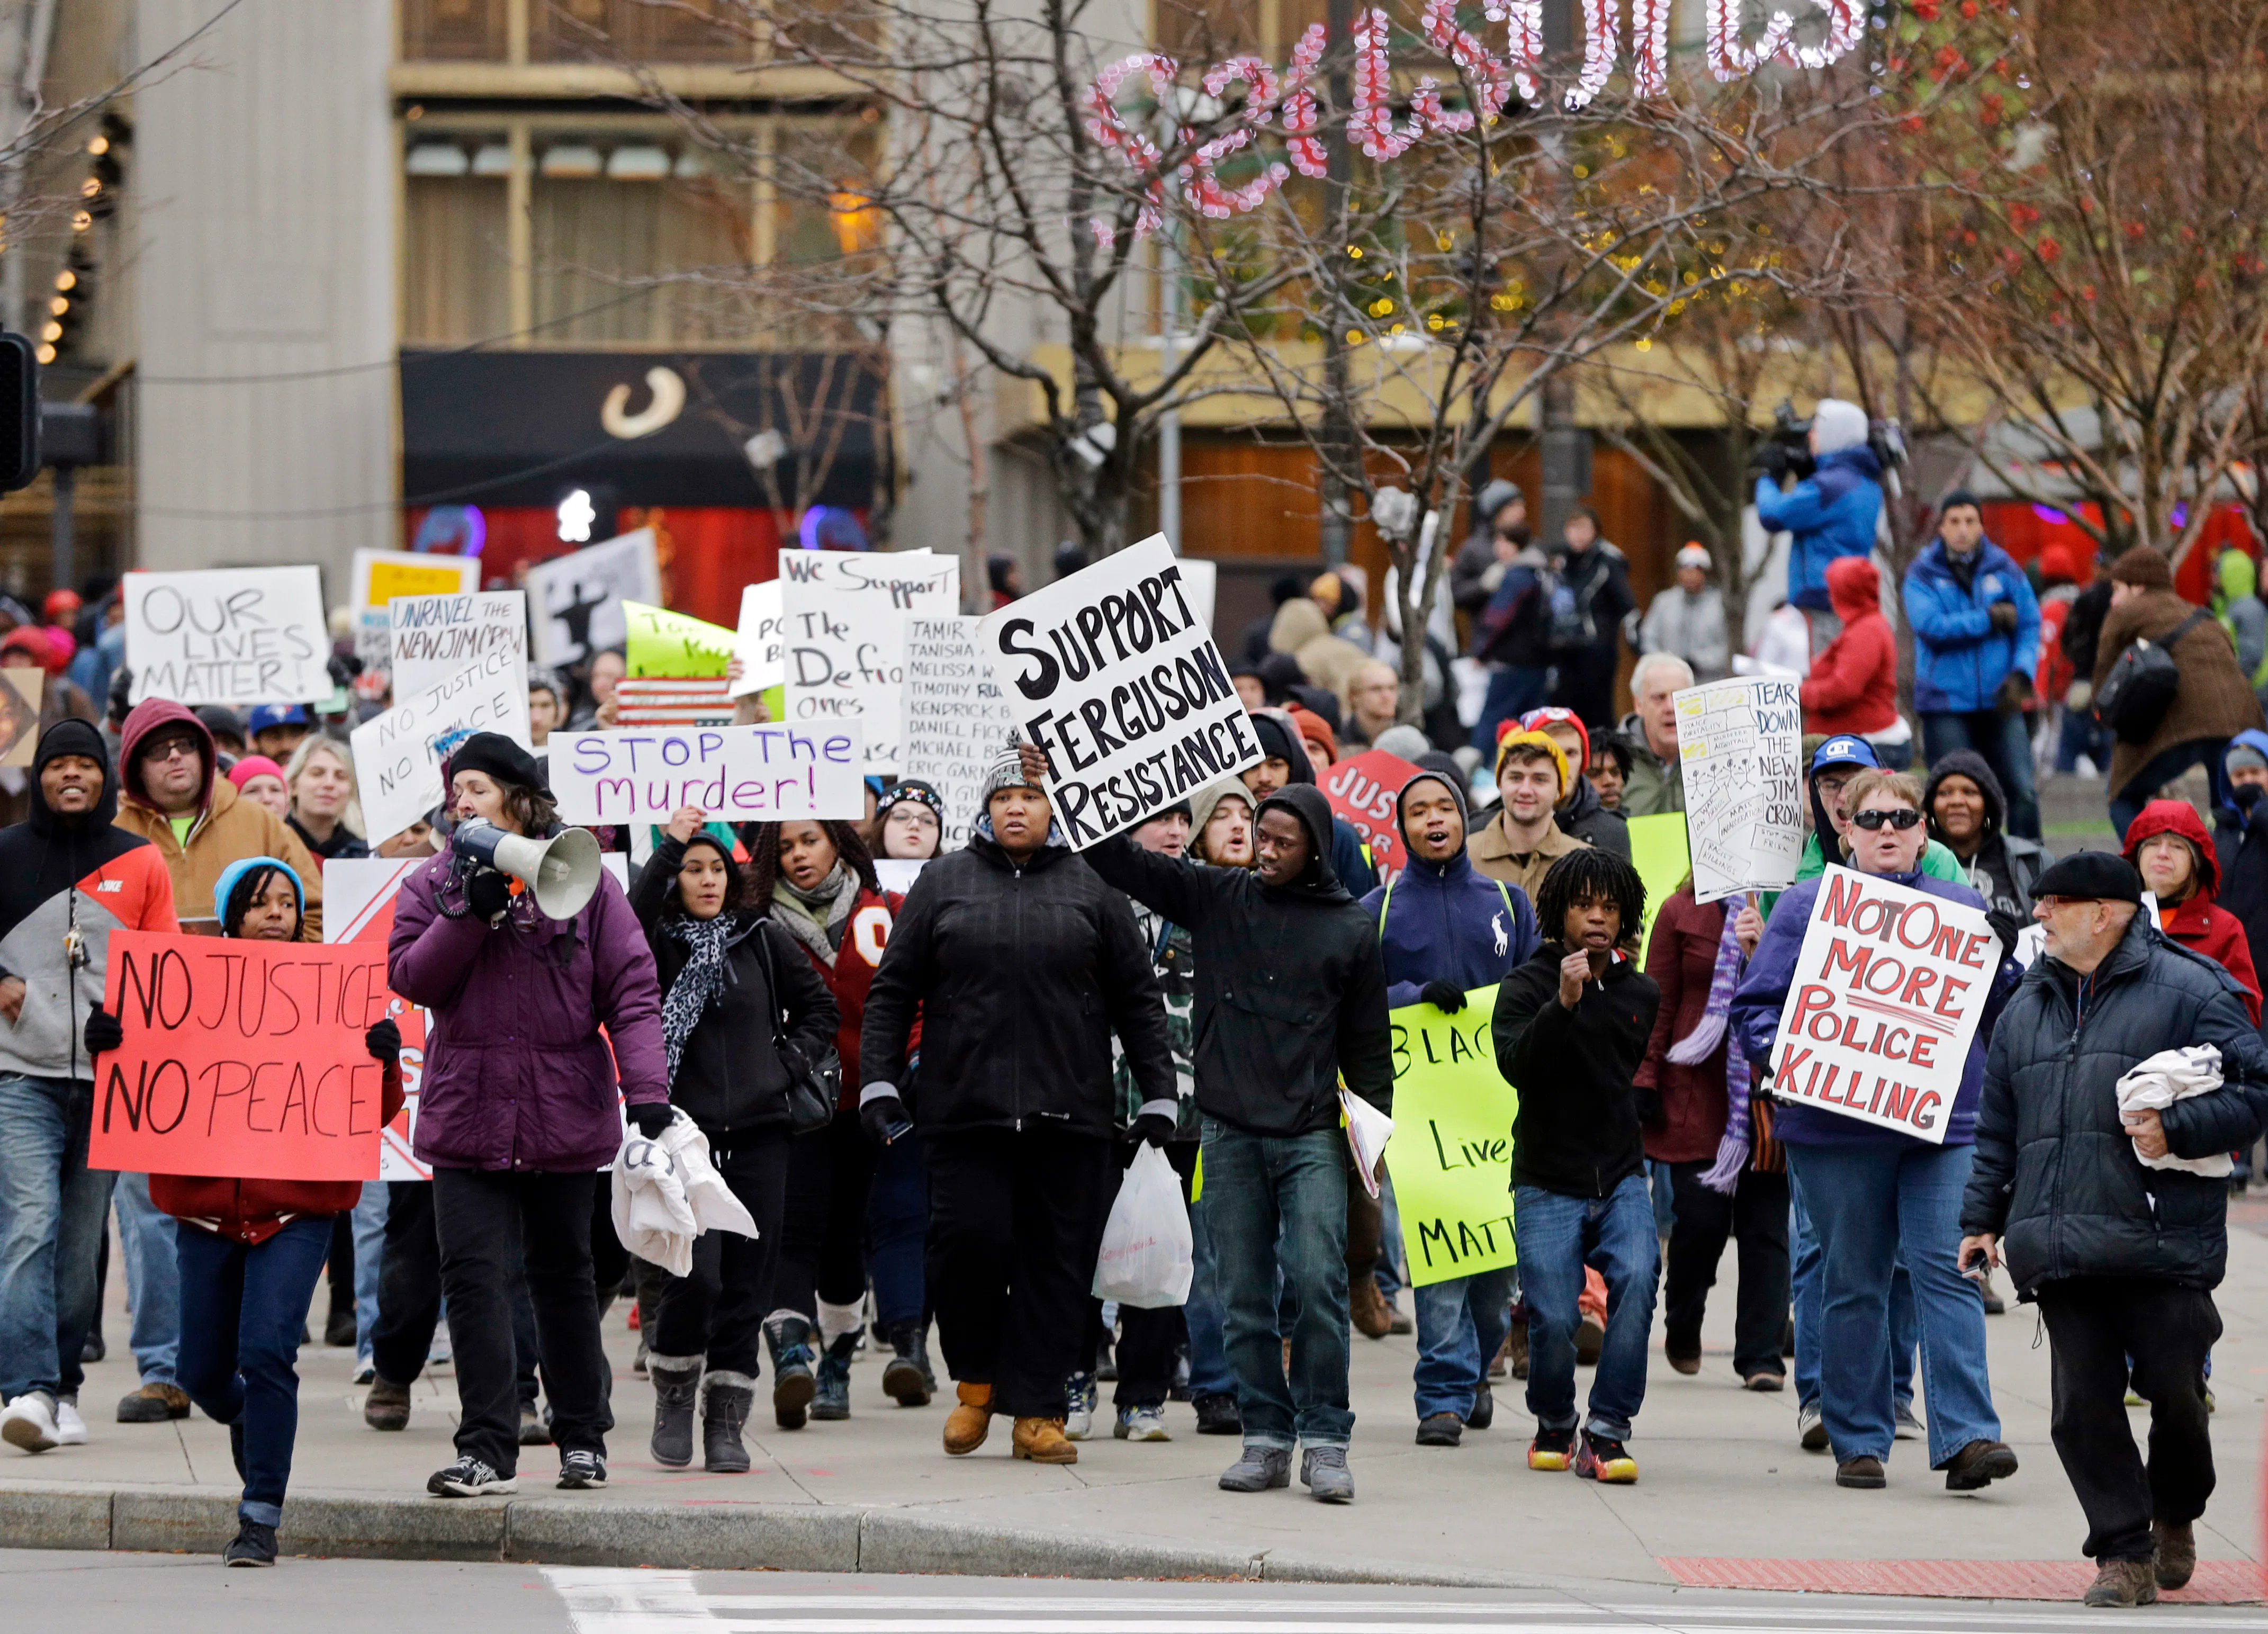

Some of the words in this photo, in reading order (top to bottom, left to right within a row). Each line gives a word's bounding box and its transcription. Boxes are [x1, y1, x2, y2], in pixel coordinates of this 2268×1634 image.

[786, 556, 825, 583] We
[142, 585, 267, 634] OUR
[393, 596, 473, 630] UNRAVEL
[482, 602, 511, 618] THE
[797, 610, 850, 642] The
[913, 621, 965, 640] TAMIR
[999, 565, 1196, 700] SUPPORT
[183, 624, 313, 661] LIVES
[395, 631, 443, 661] NEW
[439, 627, 477, 660] JIM
[909, 642, 974, 658] TANISHA
[139, 658, 304, 699] MATTER!
[910, 661, 976, 678] MELISSA
[380, 708, 413, 747] NO
[427, 643, 511, 715] JUSTICE
[1751, 681, 1800, 706] TEAR
[910, 701, 994, 720] KENDRICK
[1026, 640, 1234, 785] FERGUSON
[1756, 708, 1799, 734] DOWN
[909, 720, 966, 737] DANIEL
[574, 733, 724, 775] STOP
[908, 740, 976, 759] MICHAEL
[1759, 737, 1793, 755] THE
[380, 757, 412, 796] NO
[907, 760, 943, 777] ERIC
[1052, 709, 1258, 847] RESISTANCE
[1758, 755, 1798, 777] NEW
[1763, 778, 1799, 803] JIM
[1696, 818, 1706, 831] ON
[1766, 803, 1801, 828] CROW
[1708, 842, 1734, 861] RACIST
[1763, 838, 1788, 853] FRISK
[1782, 834, 1796, 843] AND
[1703, 851, 1736, 875] KILLINGS
[96, 879, 124, 893] NIKE
[1819, 937, 1972, 1019] MORE
[115, 948, 193, 1030] NO
[197, 954, 386, 1038] JUSTICE
[1788, 984, 1939, 1069] POLICE
[103, 1060, 190, 1134] NO
[1774, 1043, 1941, 1129] KILLING
